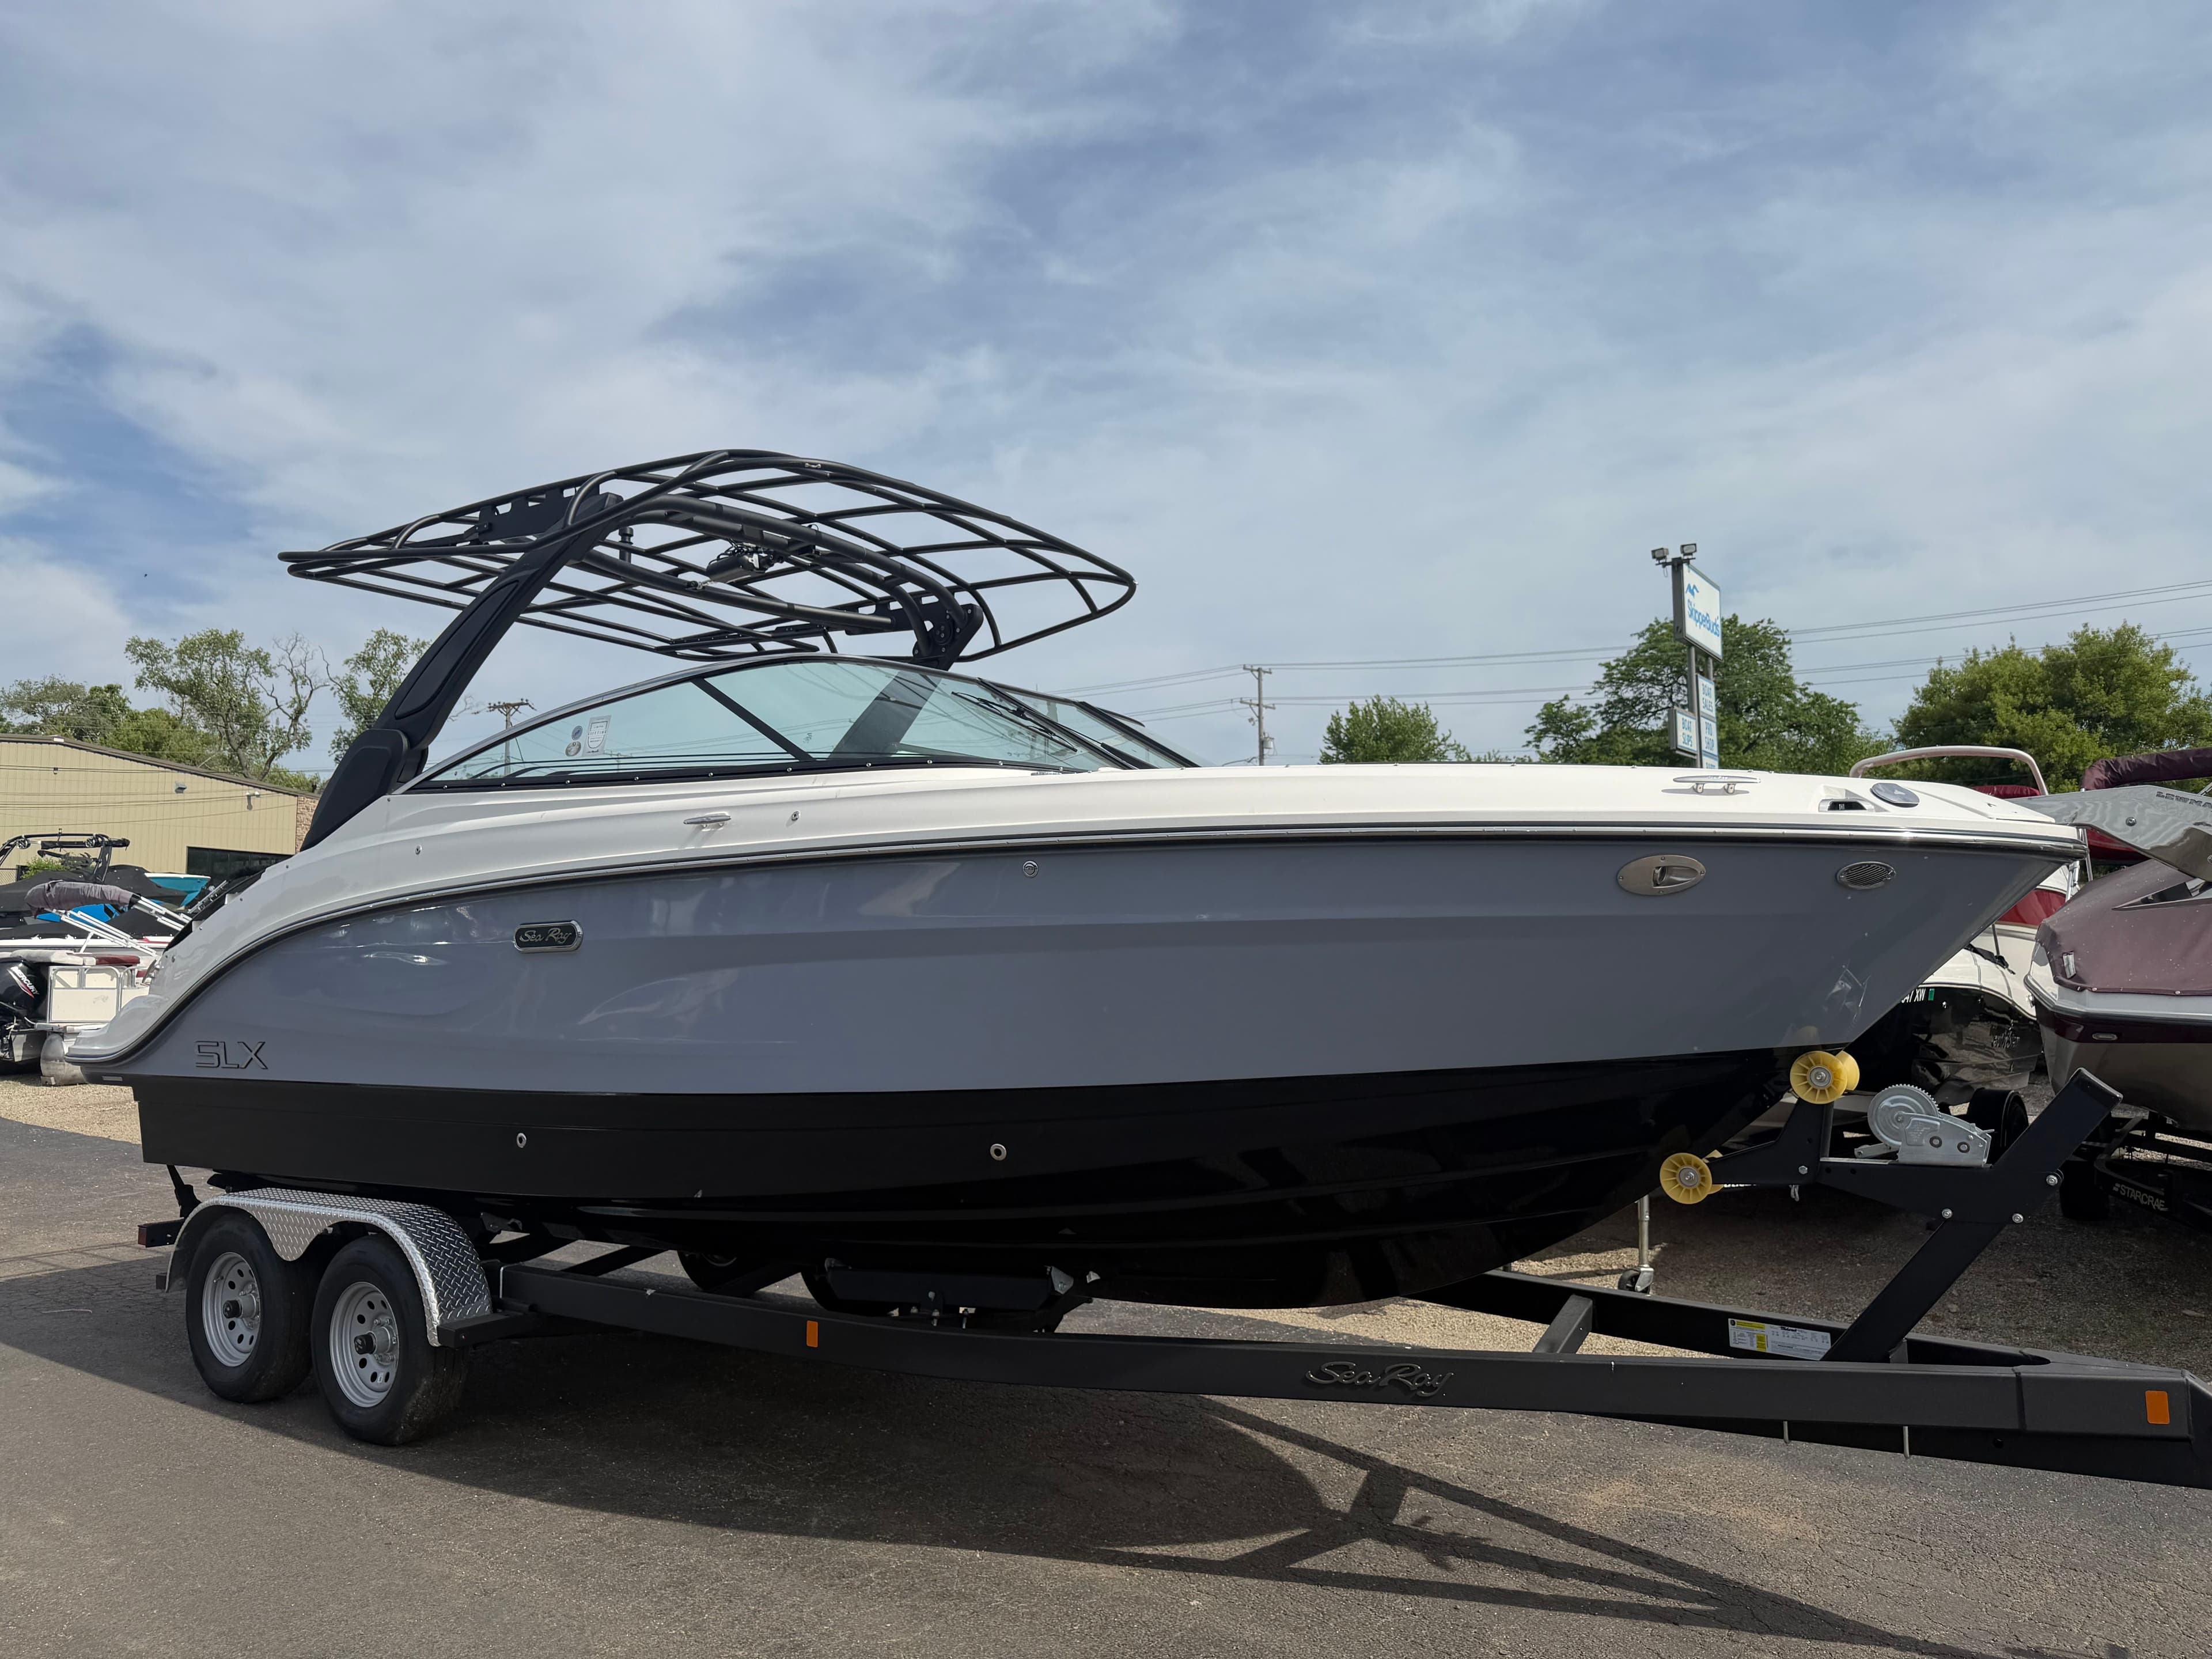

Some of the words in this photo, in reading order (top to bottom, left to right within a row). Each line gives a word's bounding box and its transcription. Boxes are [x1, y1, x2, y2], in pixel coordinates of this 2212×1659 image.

[1702, 683, 1712, 698] BOAT
[1702, 698, 1713, 713] SALES
[1681, 717, 1692, 733] BOAT
[1705, 721, 1713, 737] PRO
[1682, 733, 1692, 747] SLIPS
[1705, 736, 1714, 751] SHOP
[520, 930, 544, 942] Sea
[545, 927, 572, 945] Ray
[10, 963, 40, 995] MERCURY
[195, 1040, 268, 1070] SLX
[1305, 1360, 1381, 1386] Sea
[1378, 1362, 1455, 1397] Ray
